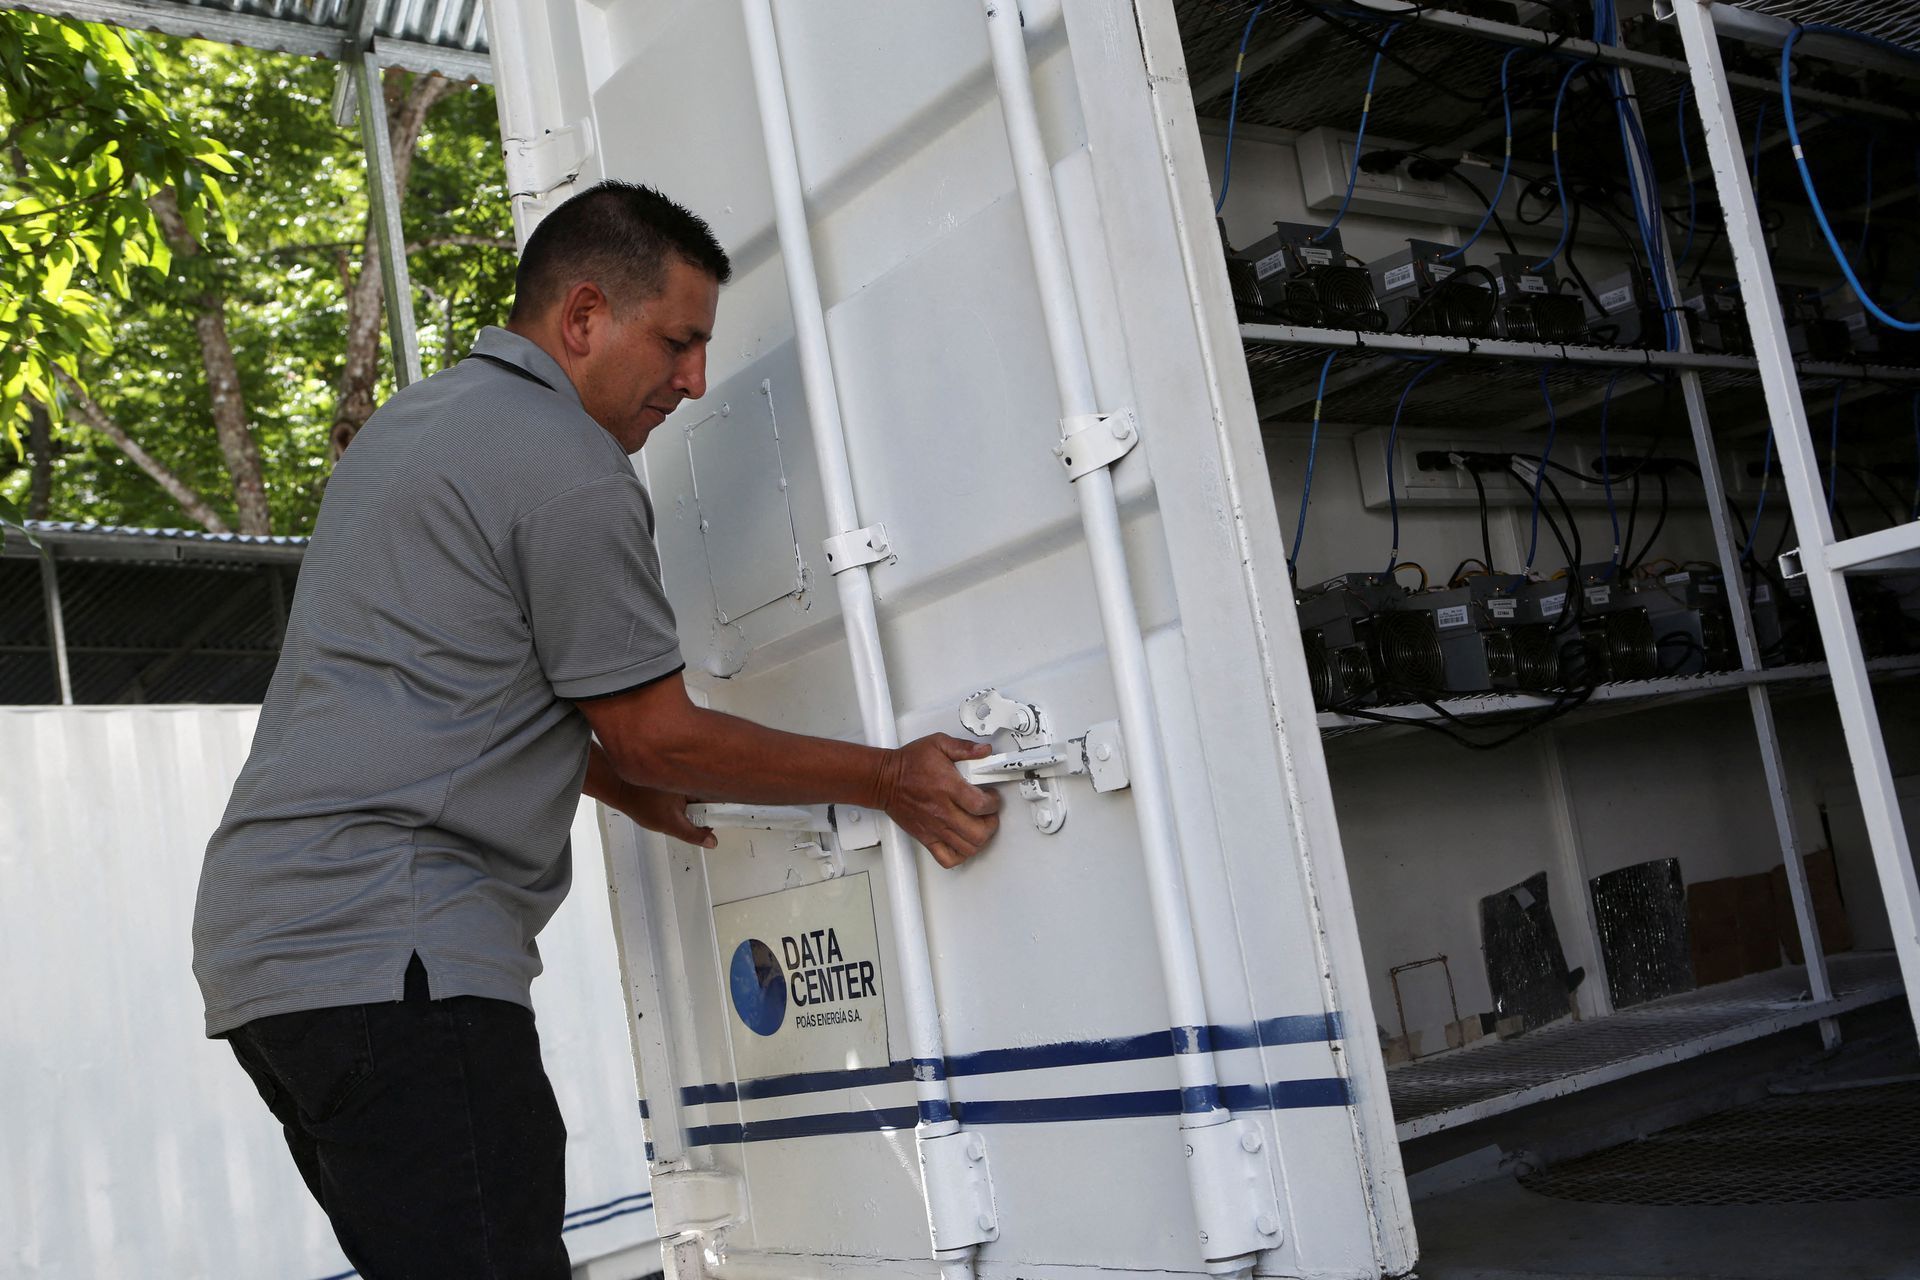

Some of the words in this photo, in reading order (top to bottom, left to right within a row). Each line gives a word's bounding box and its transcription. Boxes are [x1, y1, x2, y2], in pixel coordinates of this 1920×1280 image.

[781, 928, 843, 970] DATA
[790, 960, 877, 1007] CENTER
[796, 1012, 817, 1029] POÁS
[817, 1008, 848, 1027] ENERGÍA
[848, 1009, 863, 1023] S.A.
